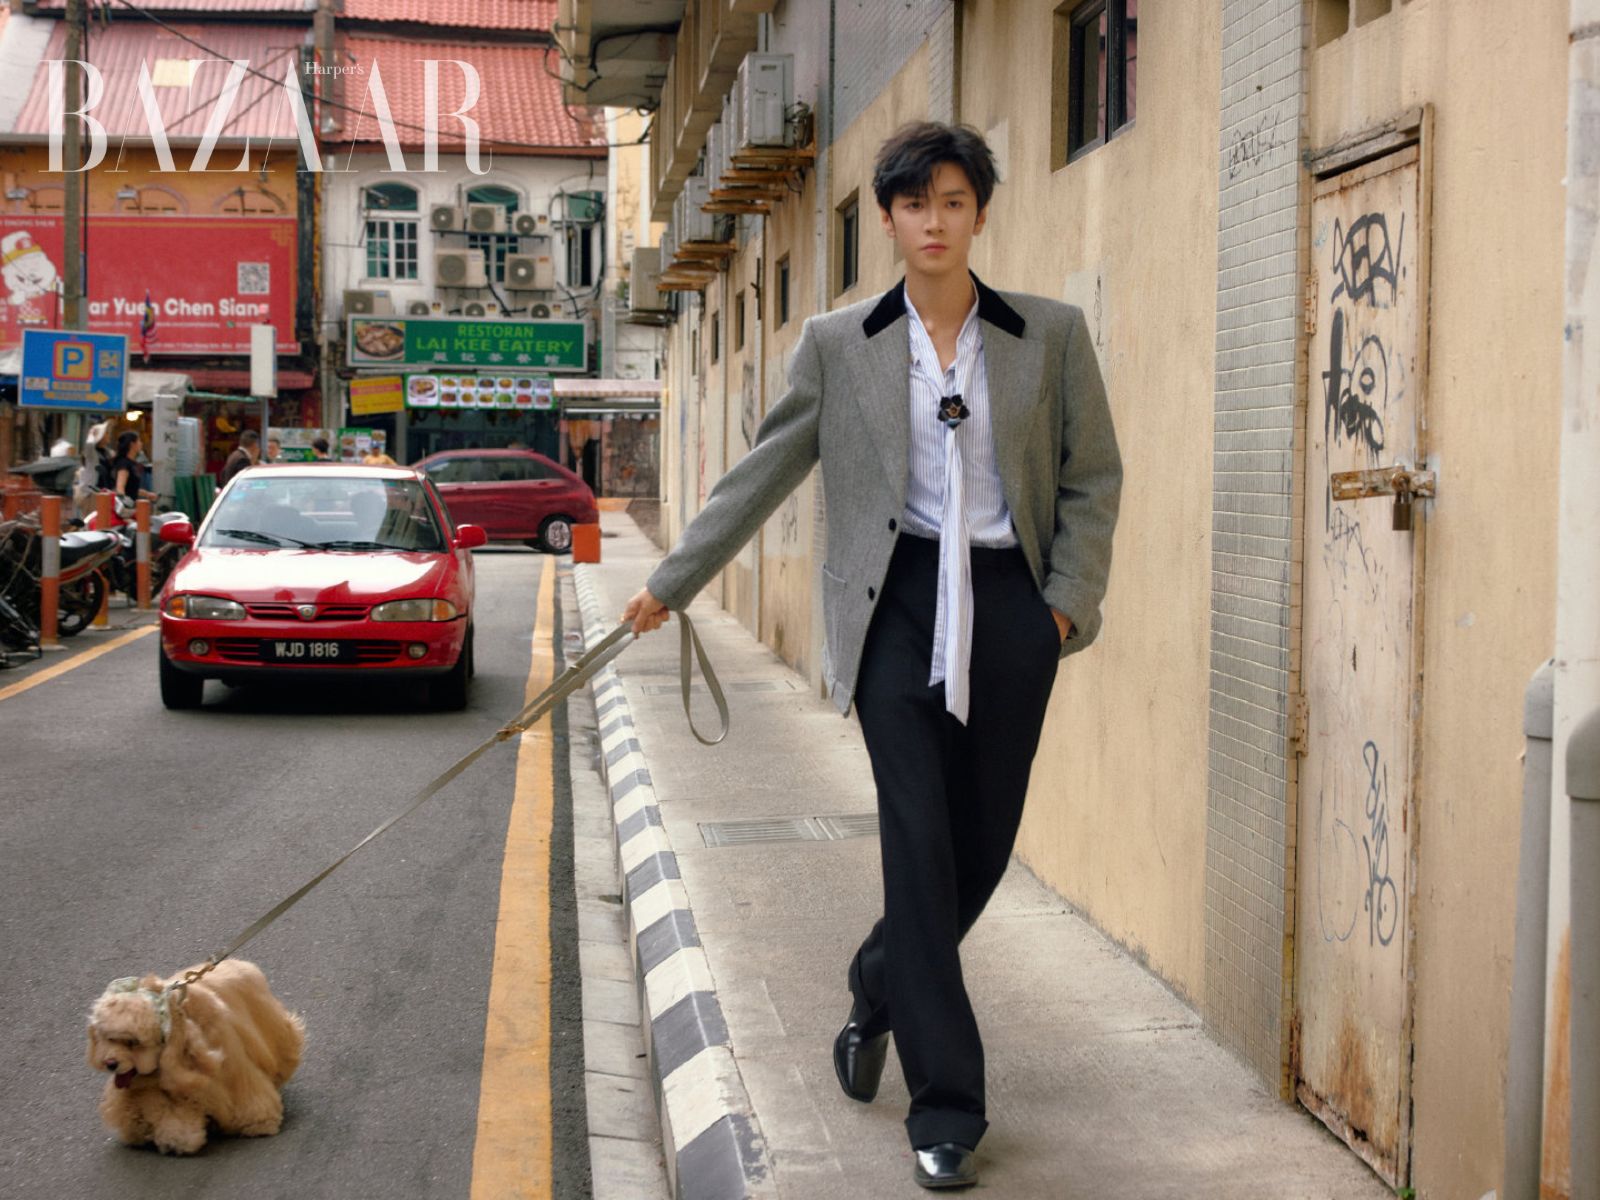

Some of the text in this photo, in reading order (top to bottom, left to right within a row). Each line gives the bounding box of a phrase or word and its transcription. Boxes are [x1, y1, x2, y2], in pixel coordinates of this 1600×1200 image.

[164, 298, 215, 316] Chen
[457, 324, 534, 338] RESTORAN
[416, 337, 575, 353] LAI KEE EATERY
[62, 347, 84, 375] P
[275, 642, 339, 657] WJD 1816
